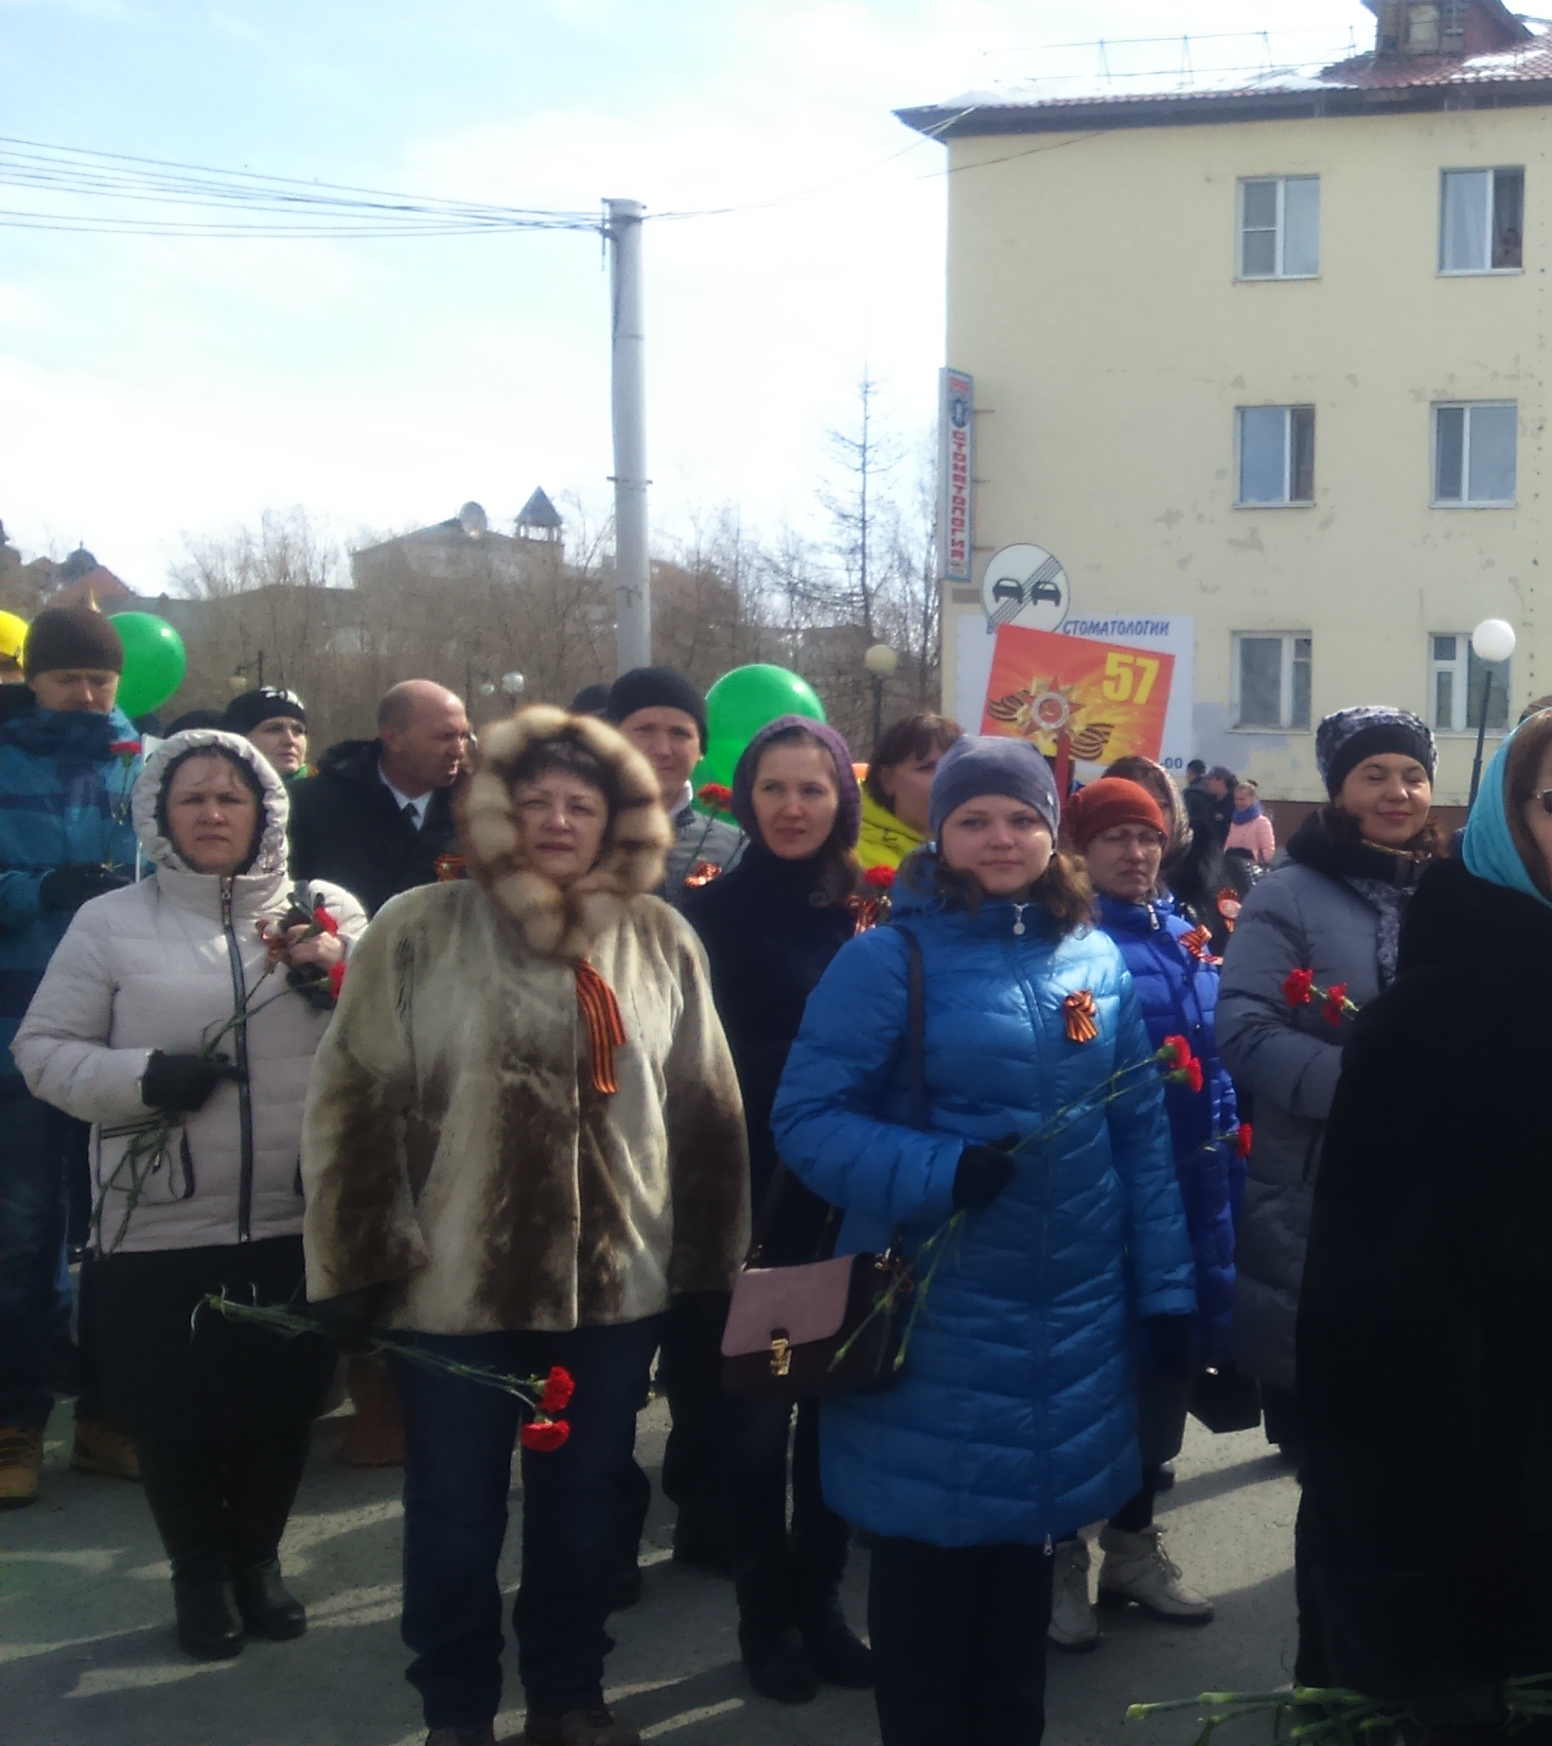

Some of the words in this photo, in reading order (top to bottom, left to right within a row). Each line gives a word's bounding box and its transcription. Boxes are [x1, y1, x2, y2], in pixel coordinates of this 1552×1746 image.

[951, 430, 966, 560] СТОМАТОЛОГИЯ
[1063, 620, 1170, 635] СТОМАТОЛОГИИ
[1102, 652, 1159, 705] 57
